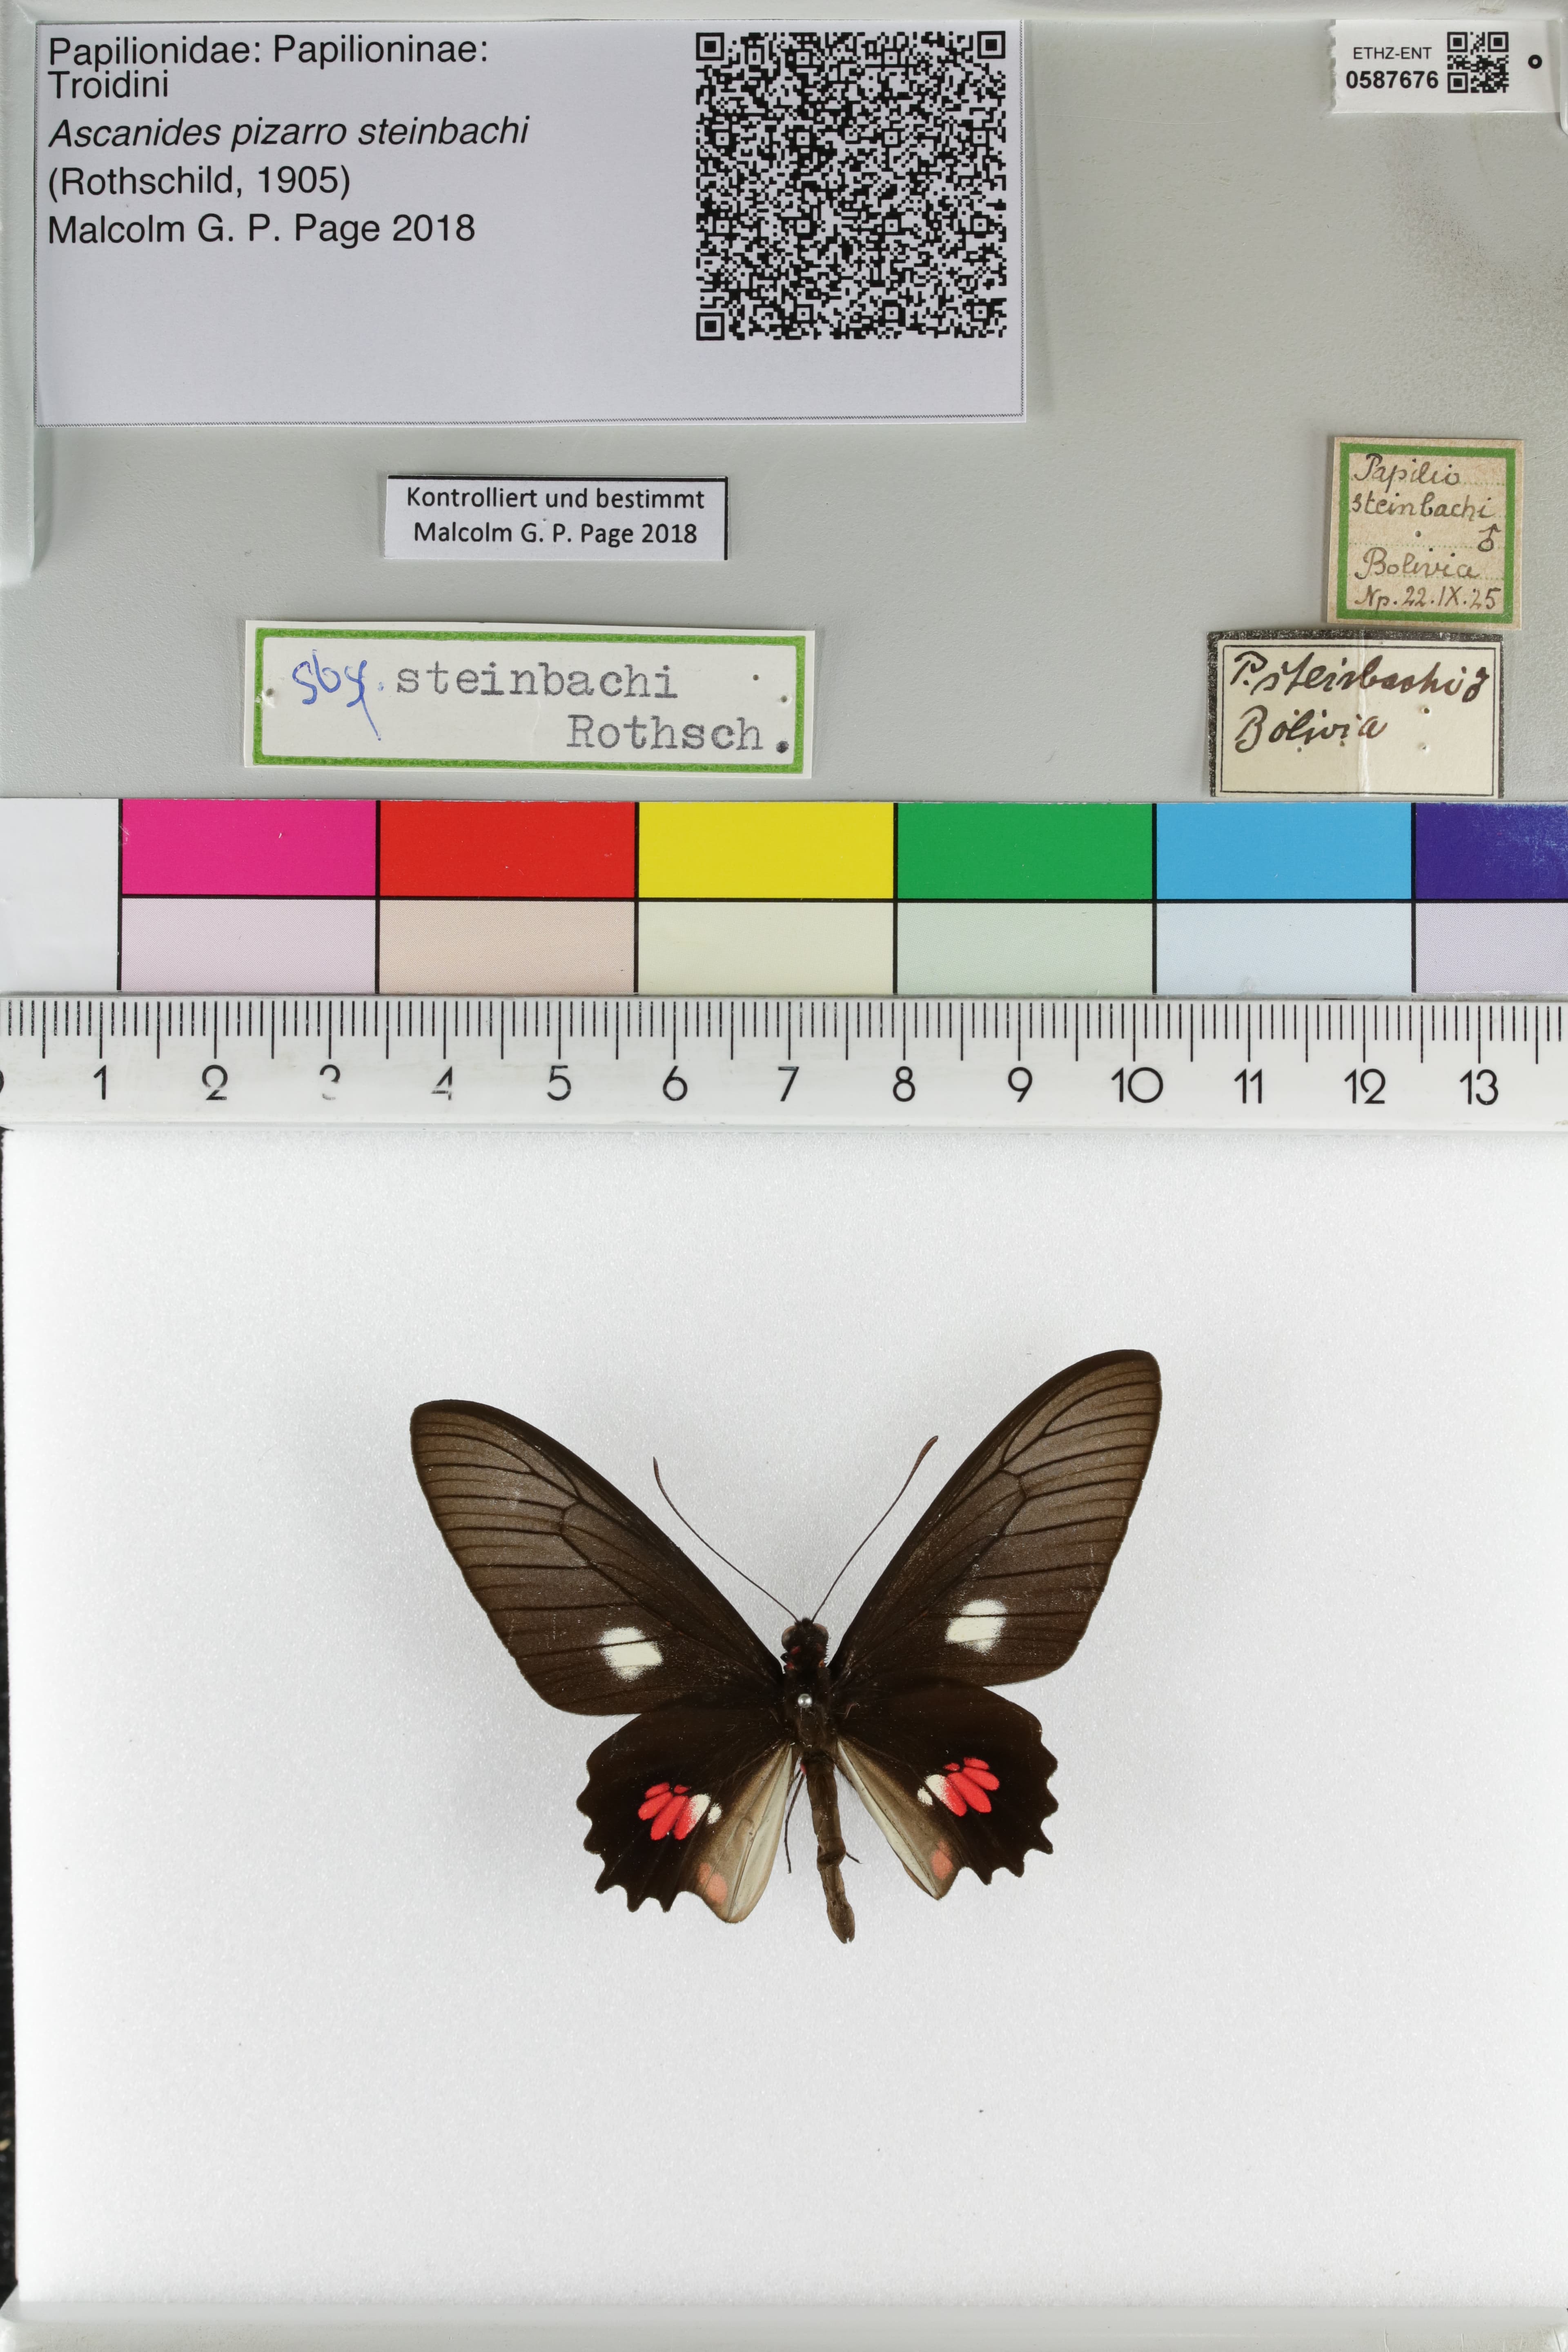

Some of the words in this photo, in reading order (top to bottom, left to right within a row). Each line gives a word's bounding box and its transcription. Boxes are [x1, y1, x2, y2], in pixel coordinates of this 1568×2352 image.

[48, 36, 259, 71] Papilionidae:
[275, 34, 486, 69] Papilioninae:
[1354, 47, 1432, 59] ETHZ-ENT
[48, 68, 167, 99] Troidini
[1346, 71, 1438, 89] 0587676
[48, 118, 221, 147] Ascanides
[231, 117, 346, 152] pizarro
[359, 116, 530, 145] steinbachi
[49, 165, 241, 203] (Rothschild,
[258, 165, 350, 200] 1905)
[49, 215, 184, 244] Malcolm
[198, 214, 233, 242] G.
[249, 214, 279, 241] P.
[296, 214, 379, 249] Page
[393, 214, 474, 241] 2018
[408, 487, 537, 508] Kontrolliert
[546, 488, 587, 508] und
[597, 488, 704, 509] bestimmt
[415, 522, 512, 542] Malcolm
[521, 523, 543, 542] G.
[553, 523, 571, 542] P.
[581, 523, 633, 548] Page
[642, 523, 697, 543] 2018
[397, 661, 677, 698] steinbachi
[94, 1065, 106, 1100] 1
[202, 1065, 228, 1100] 2
[432, 1066, 452, 1100] 4
[548, 1065, 571, 1101] 5
[663, 1066, 688, 1101] 6
[778, 1067, 799, 1101] 7
[893, 1066, 915, 1102] 8
[1008, 1067, 1032, 1102] 9
[1111, 1067, 1163, 1103] 10
[1234, 1069, 1262, 1104] 11
[1344, 1069, 1385, 1104] 12
[1460, 1069, 1498, 1105] 13
